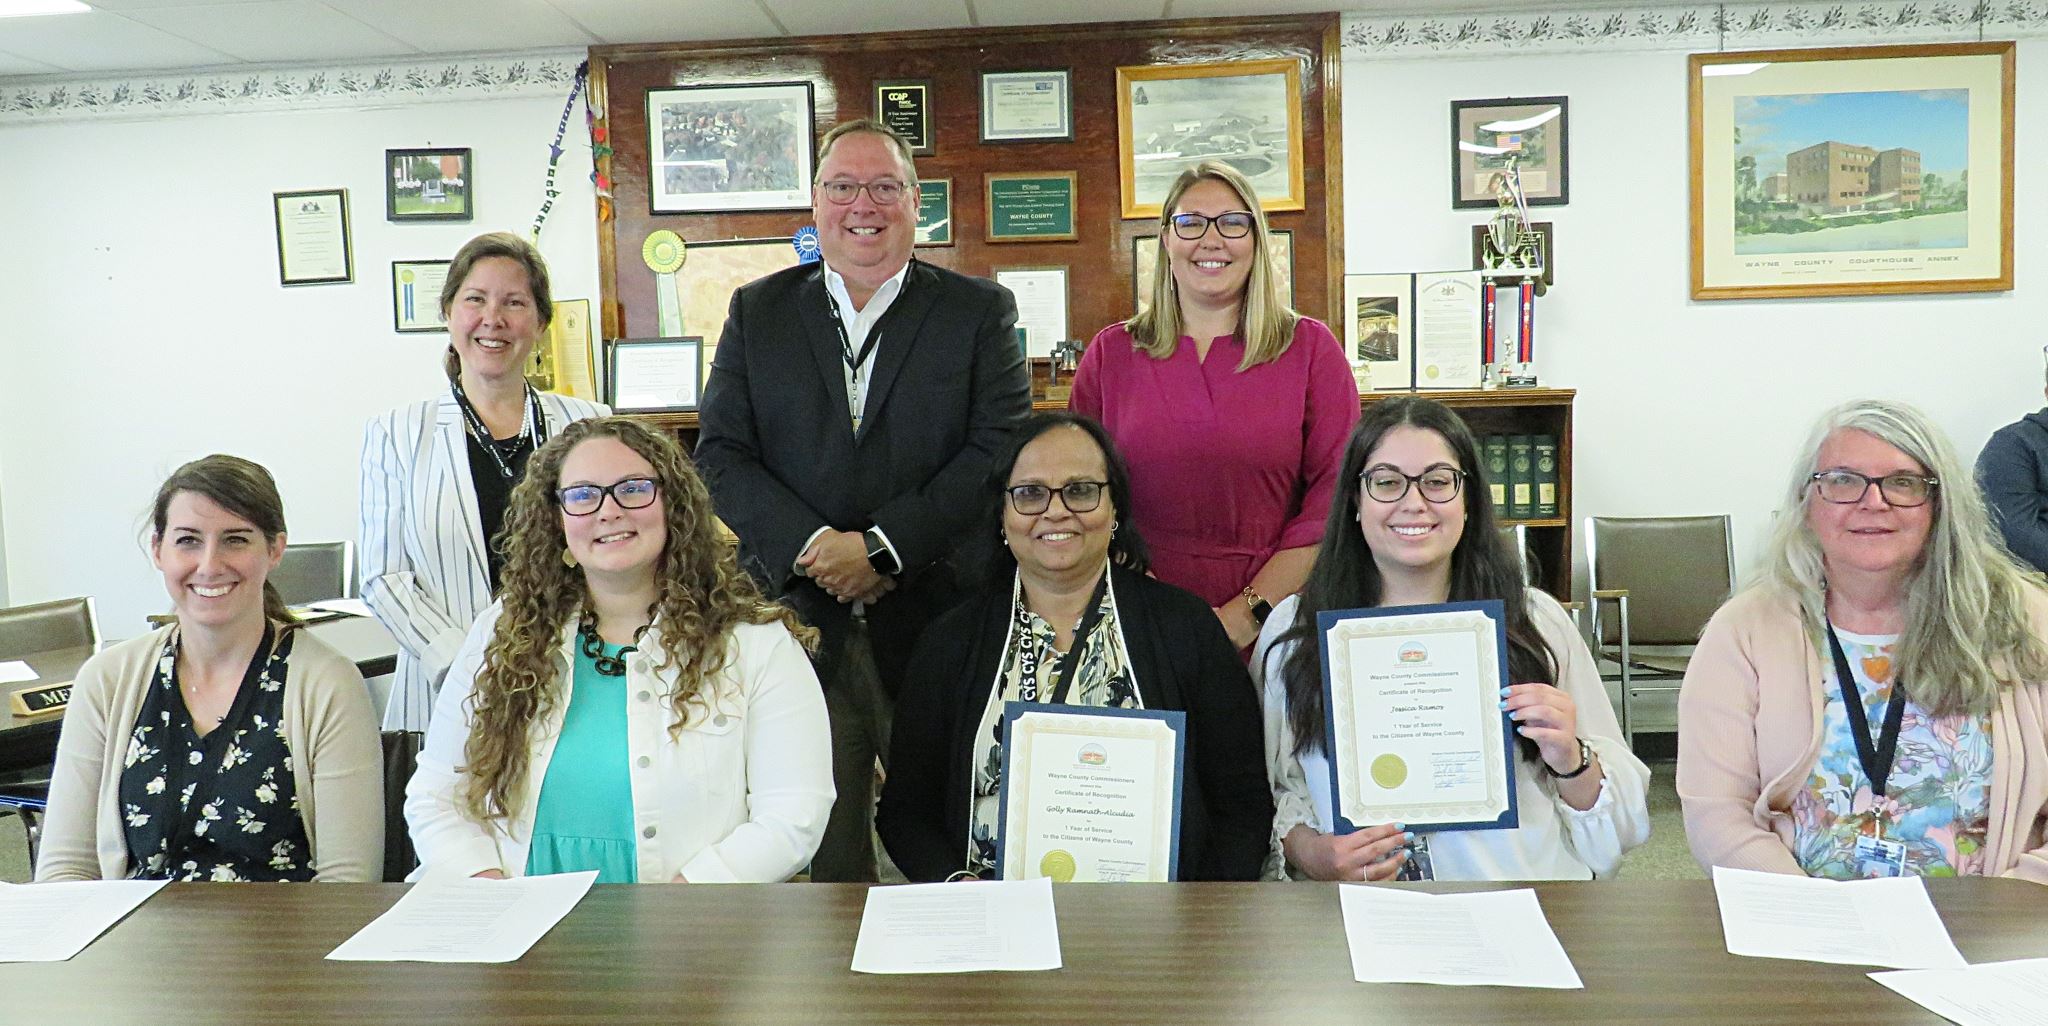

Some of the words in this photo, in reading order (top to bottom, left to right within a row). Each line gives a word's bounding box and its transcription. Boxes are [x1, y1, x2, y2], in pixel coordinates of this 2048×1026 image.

[1021, 626, 1032, 649] CYS
[1022, 652, 1035, 674] CYS
[1024, 678, 1036, 701] CYS
[1390, 705, 1416, 713] Jessica
[1090, 775, 1135, 783] Commissioners
[1046, 806, 1064, 814] Golly
[1066, 806, 1135, 817] Ramnath-Alcudia
